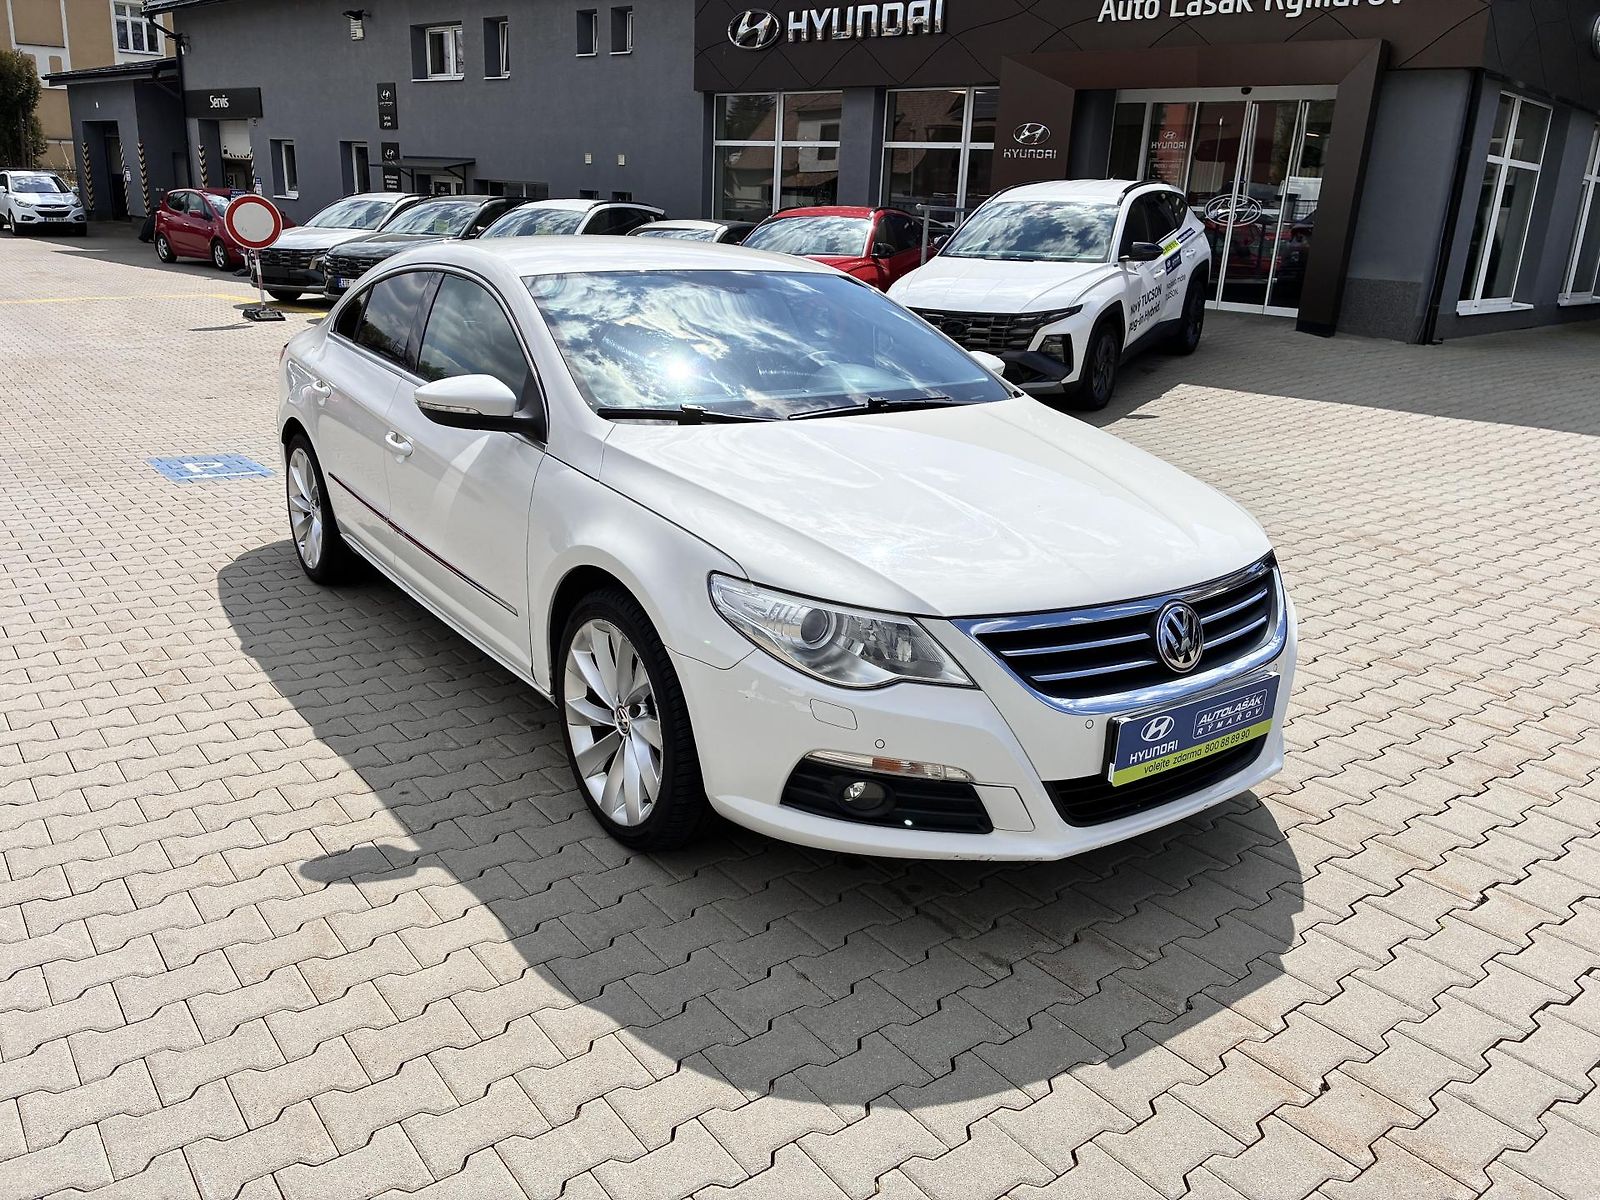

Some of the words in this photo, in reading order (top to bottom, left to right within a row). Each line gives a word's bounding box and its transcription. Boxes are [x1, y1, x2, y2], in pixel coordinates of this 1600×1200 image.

[788, 0, 943, 42] HYUNDAI
[1003, 148, 1057, 159] HYUNDAI
[1151, 141, 1187, 149] HYUNDAI
[1141, 283, 1162, 306] TUCSON
[1198, 693, 1264, 724] AUTOLAŠÁK
[1129, 739, 1179, 764] HYUNDAI
[1143, 758, 1171, 774] volejte
[1172, 748, 1202, 765] zdarma
[1205, 740, 1220, 753] 800
[1219, 736, 1230, 748] 88
[1230, 733, 1240, 745] 89
[1240, 728, 1251, 740] 90
